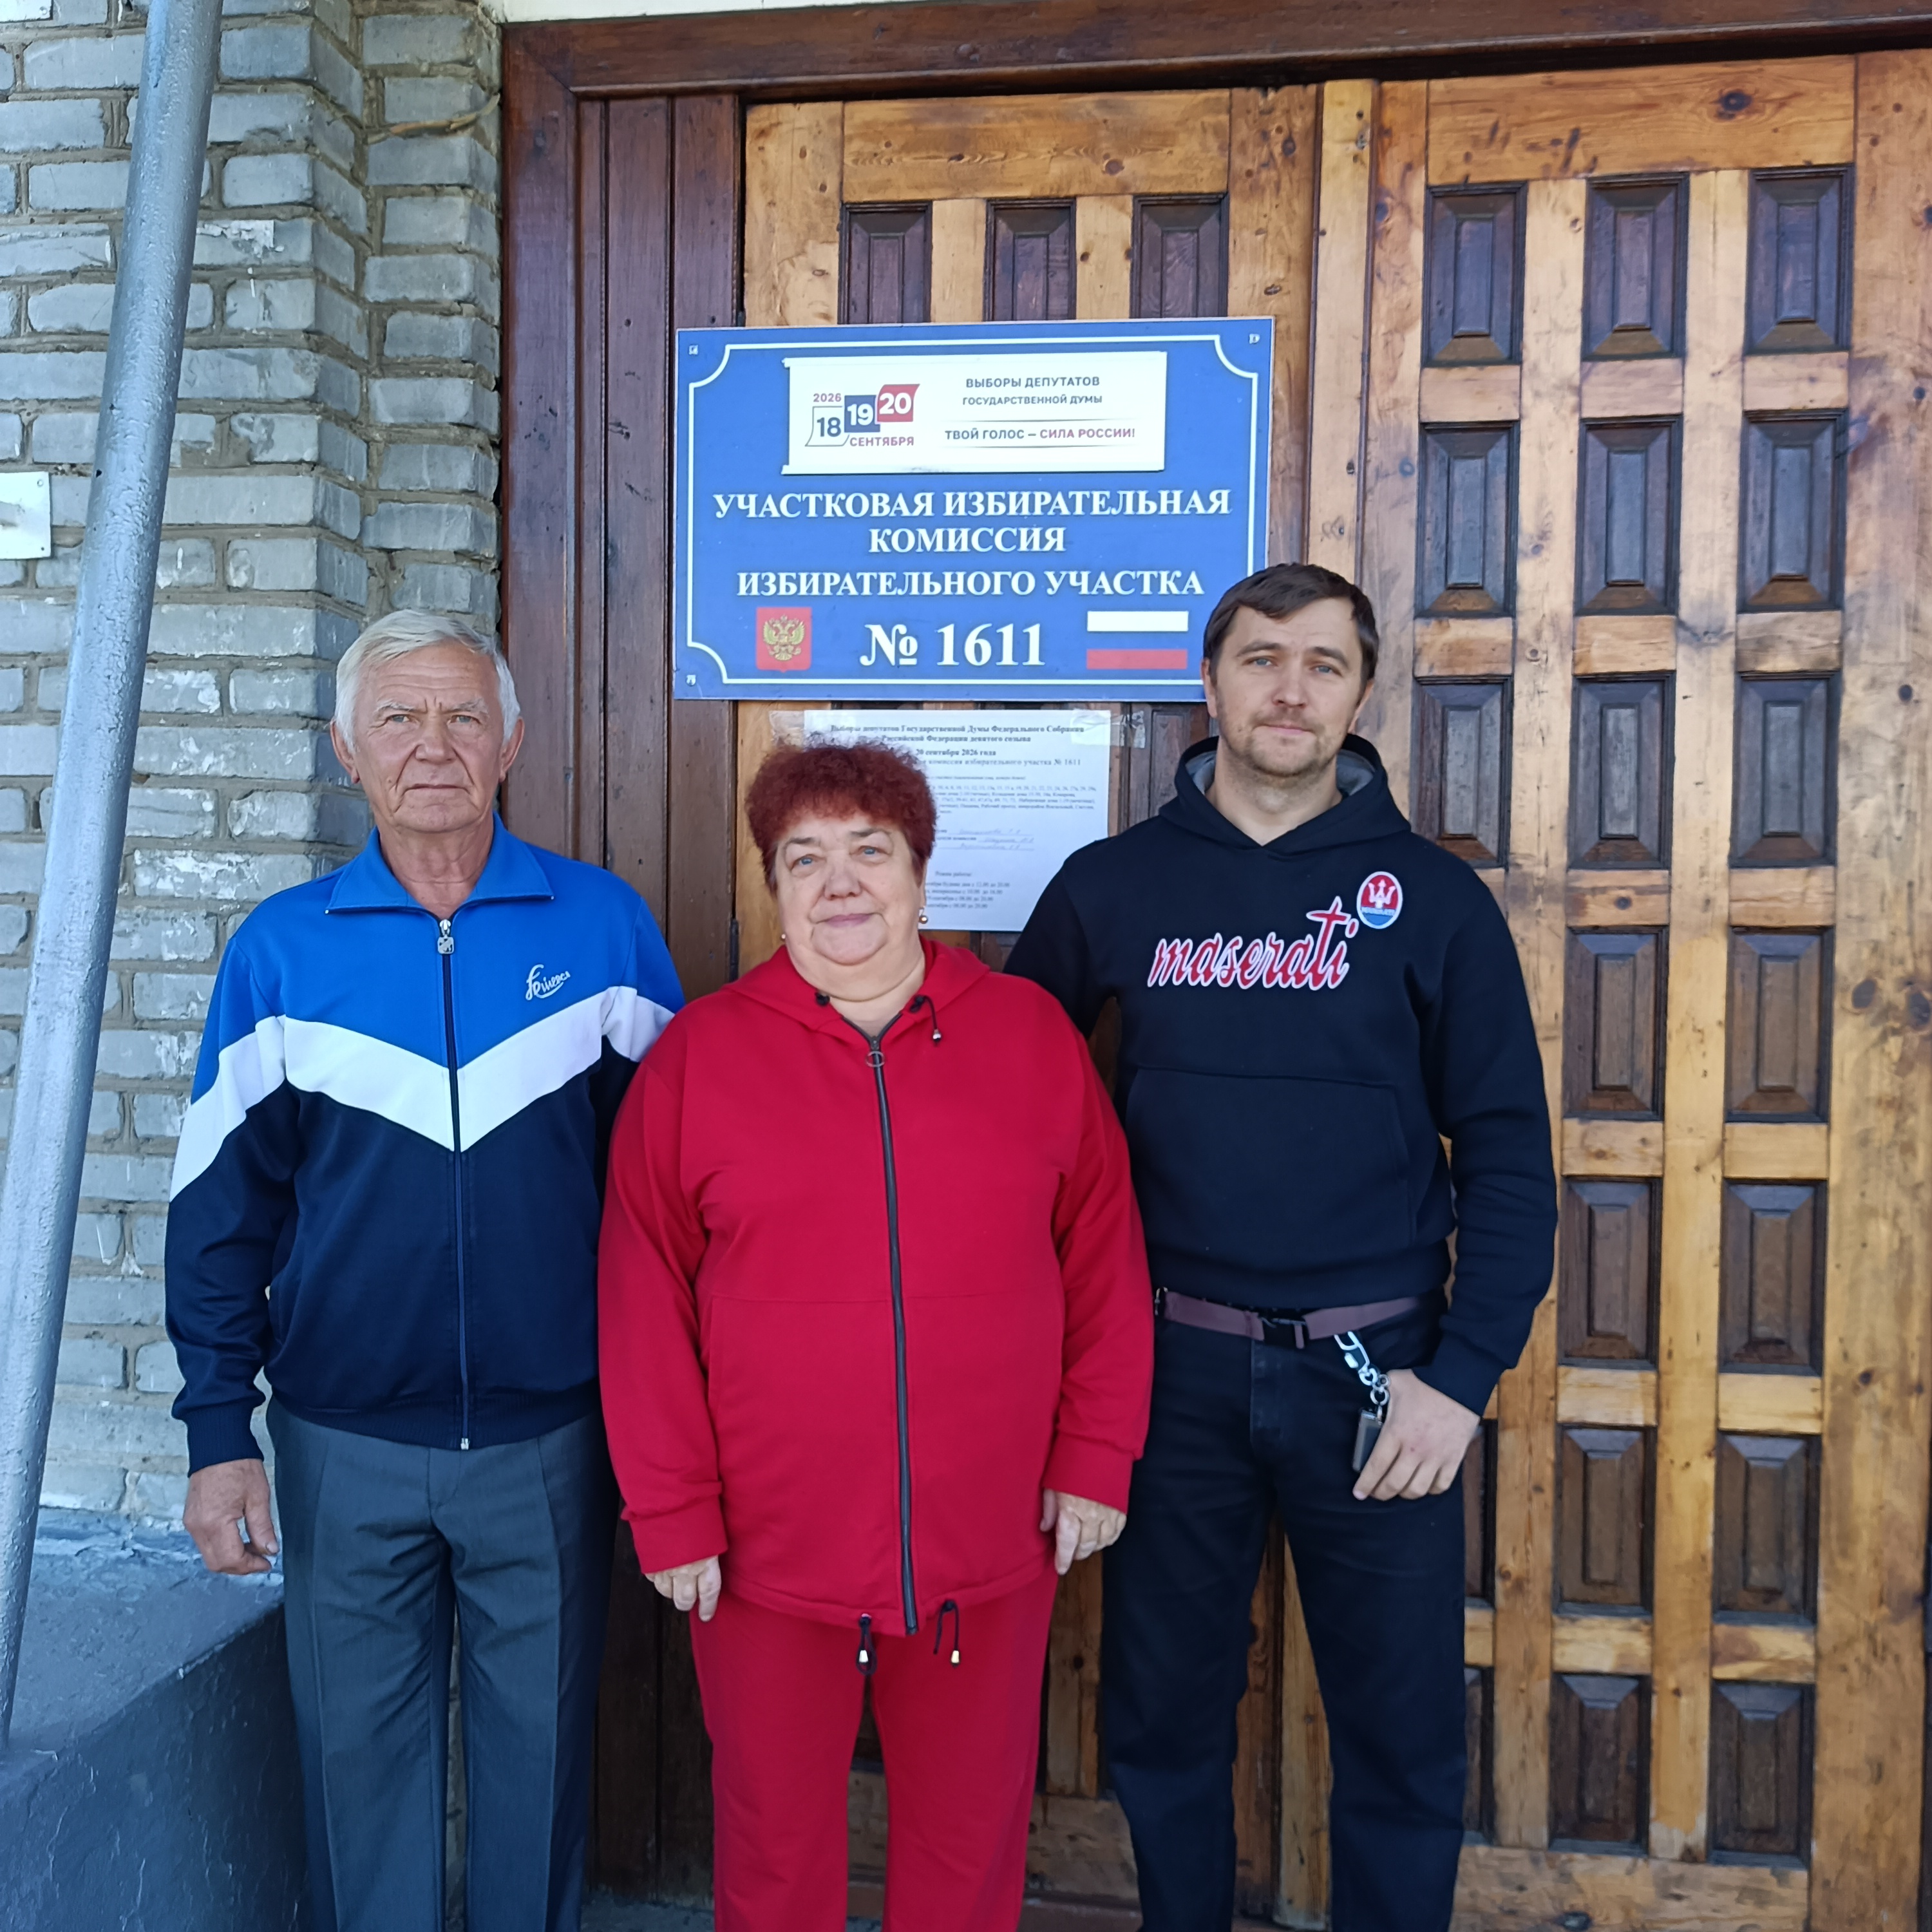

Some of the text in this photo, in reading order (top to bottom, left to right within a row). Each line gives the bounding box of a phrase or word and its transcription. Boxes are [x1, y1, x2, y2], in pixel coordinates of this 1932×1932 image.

[965, 377, 1100, 388] ВЫБОРЫ ДЕПУТАТОВ
[813, 393, 842, 402] 2026
[878, 392, 912, 414] 20
[962, 394, 1103, 406] ГОСУДАРСТВЕННОЙ ДУМЫ
[847, 403, 874, 426] 19
[817, 417, 842, 437] 18
[945, 428, 979, 440] ТВОЙ
[983, 430, 1025, 439] ГОЛОС
[1039, 429, 1075, 439] СИЛА
[1078, 428, 1135, 439] РОССИИ!
[849, 436, 914, 446] СЕНТЯБРЯ
[712, 489, 1232, 518] УЧАСТКОВАЯ ИЗБИРАТЕЛЬНАЯ
[868, 526, 1066, 553] КОМИССИЯ
[736, 569, 1206, 596] ИЗБИРАТЕЛЬНОГО УЧАСТКА
[859, 622, 1046, 667] № 1611
[967, 725, 990, 734] Думы
[991, 725, 1045, 734] Федерального
[1146, 895, 1359, 990] maserati
